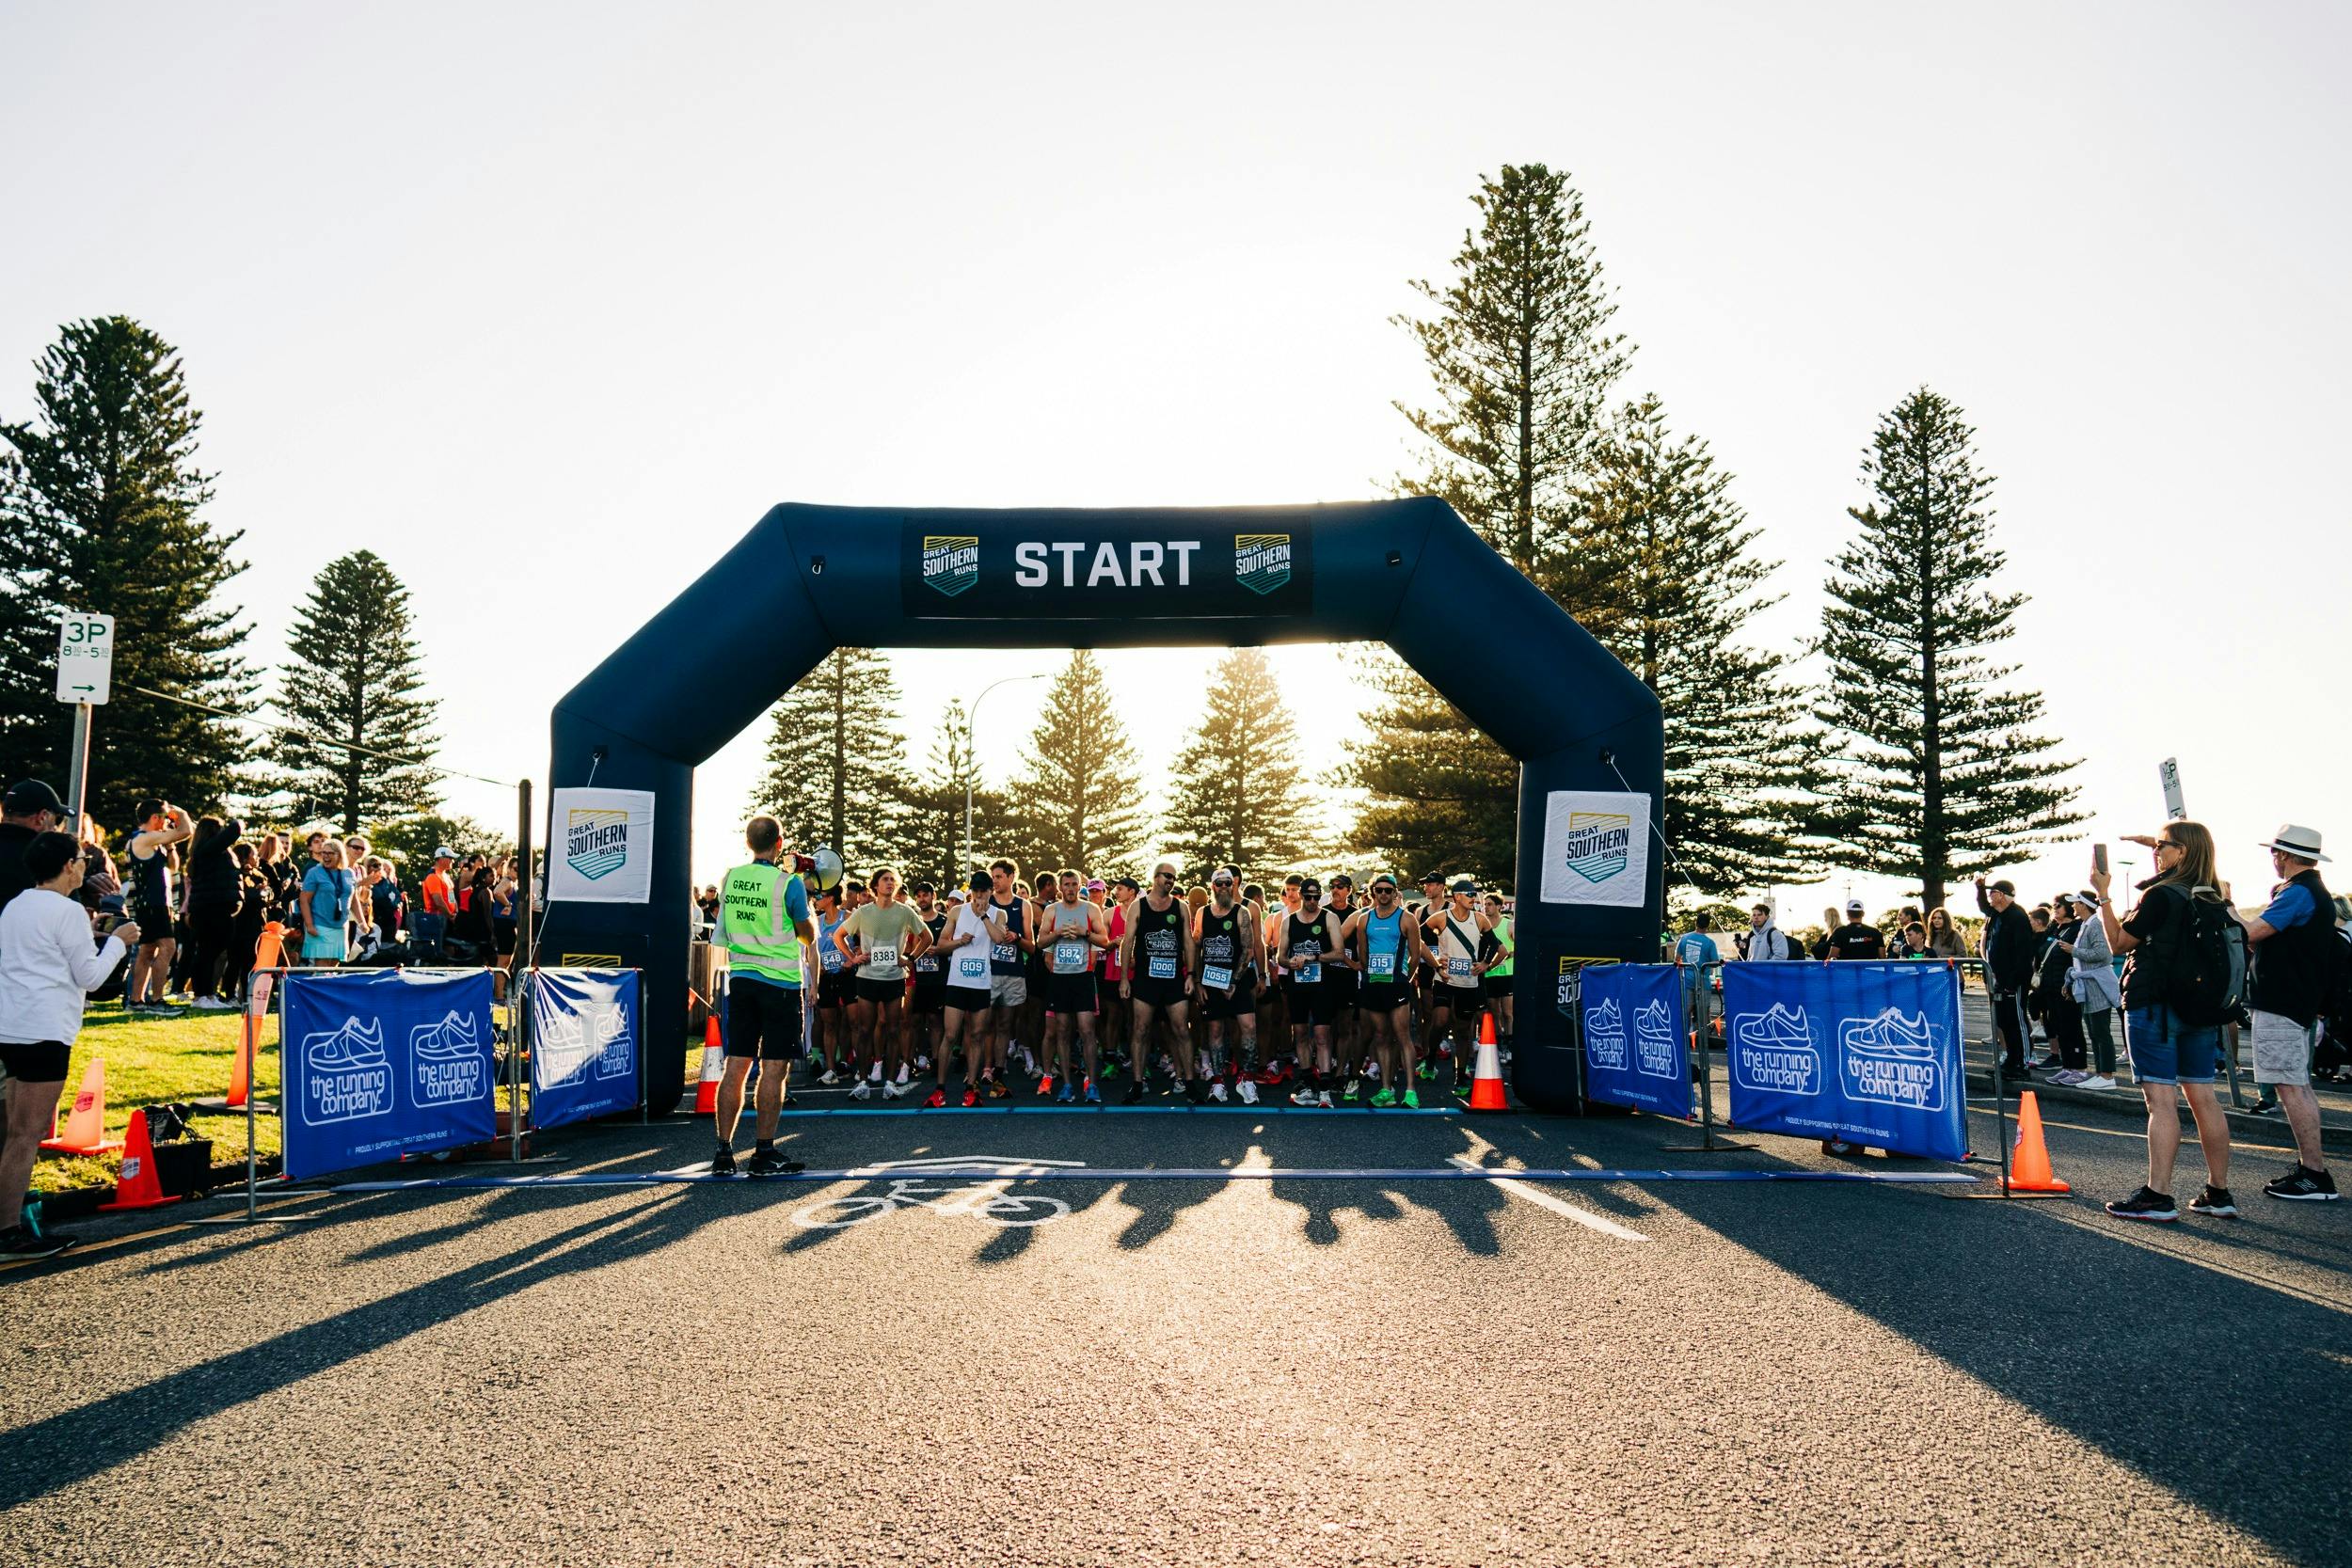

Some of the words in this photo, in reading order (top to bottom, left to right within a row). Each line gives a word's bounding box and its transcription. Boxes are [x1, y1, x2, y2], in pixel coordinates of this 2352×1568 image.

[924, 545, 950, 559] GREAT
[1235, 544, 1263, 557] GREAT
[923, 546, 978, 577] SOUTHERN
[1015, 541, 1200, 587] START
[1235, 545, 1290, 575] SOUTHERN
[953, 564, 978, 576] RUNS
[1266, 562, 1290, 574] RUNS
[67, 622, 106, 643] 3P
[568, 821, 595, 836] GREAT
[1568, 825, 1598, 839] GREAT
[567, 824, 628, 856] SOUTHERN
[1566, 828, 1629, 859] SOUTHERN
[598, 844, 627, 857] RUNS
[1601, 847, 1628, 861] RUNS
[733, 880, 762, 892] GREAT
[724, 895, 768, 908] SOUTHERN
[736, 911, 756, 922] RUNS
[873, 951, 896, 961] 8383
[995, 944, 1014, 956] 722
[1059, 948, 1079, 958] 387
[823, 954, 841, 964] 548
[919, 958, 934, 966] 123
[1371, 958, 1389, 968] 615
[1450, 960, 1469, 971] 395
[961, 961, 982, 972] 809
[1152, 962, 1173, 971] 1000
[1303, 966, 1311, 975] 2
[1206, 970, 1227, 982] 1055
[1639, 1038, 1648, 1055] the
[1648, 1042, 1672, 1060] running
[1741, 1048, 1763, 1068] the
[1764, 1050, 1811, 1076] running
[418, 1062, 437, 1084] the
[438, 1059, 479, 1081] running
[1848, 1056, 1873, 1076] the
[1875, 1060, 1934, 1088] running
[310, 1075, 334, 1099] the
[337, 1069, 386, 1095] running
[1850, 1124, 1876, 1135] SOUTHERN
